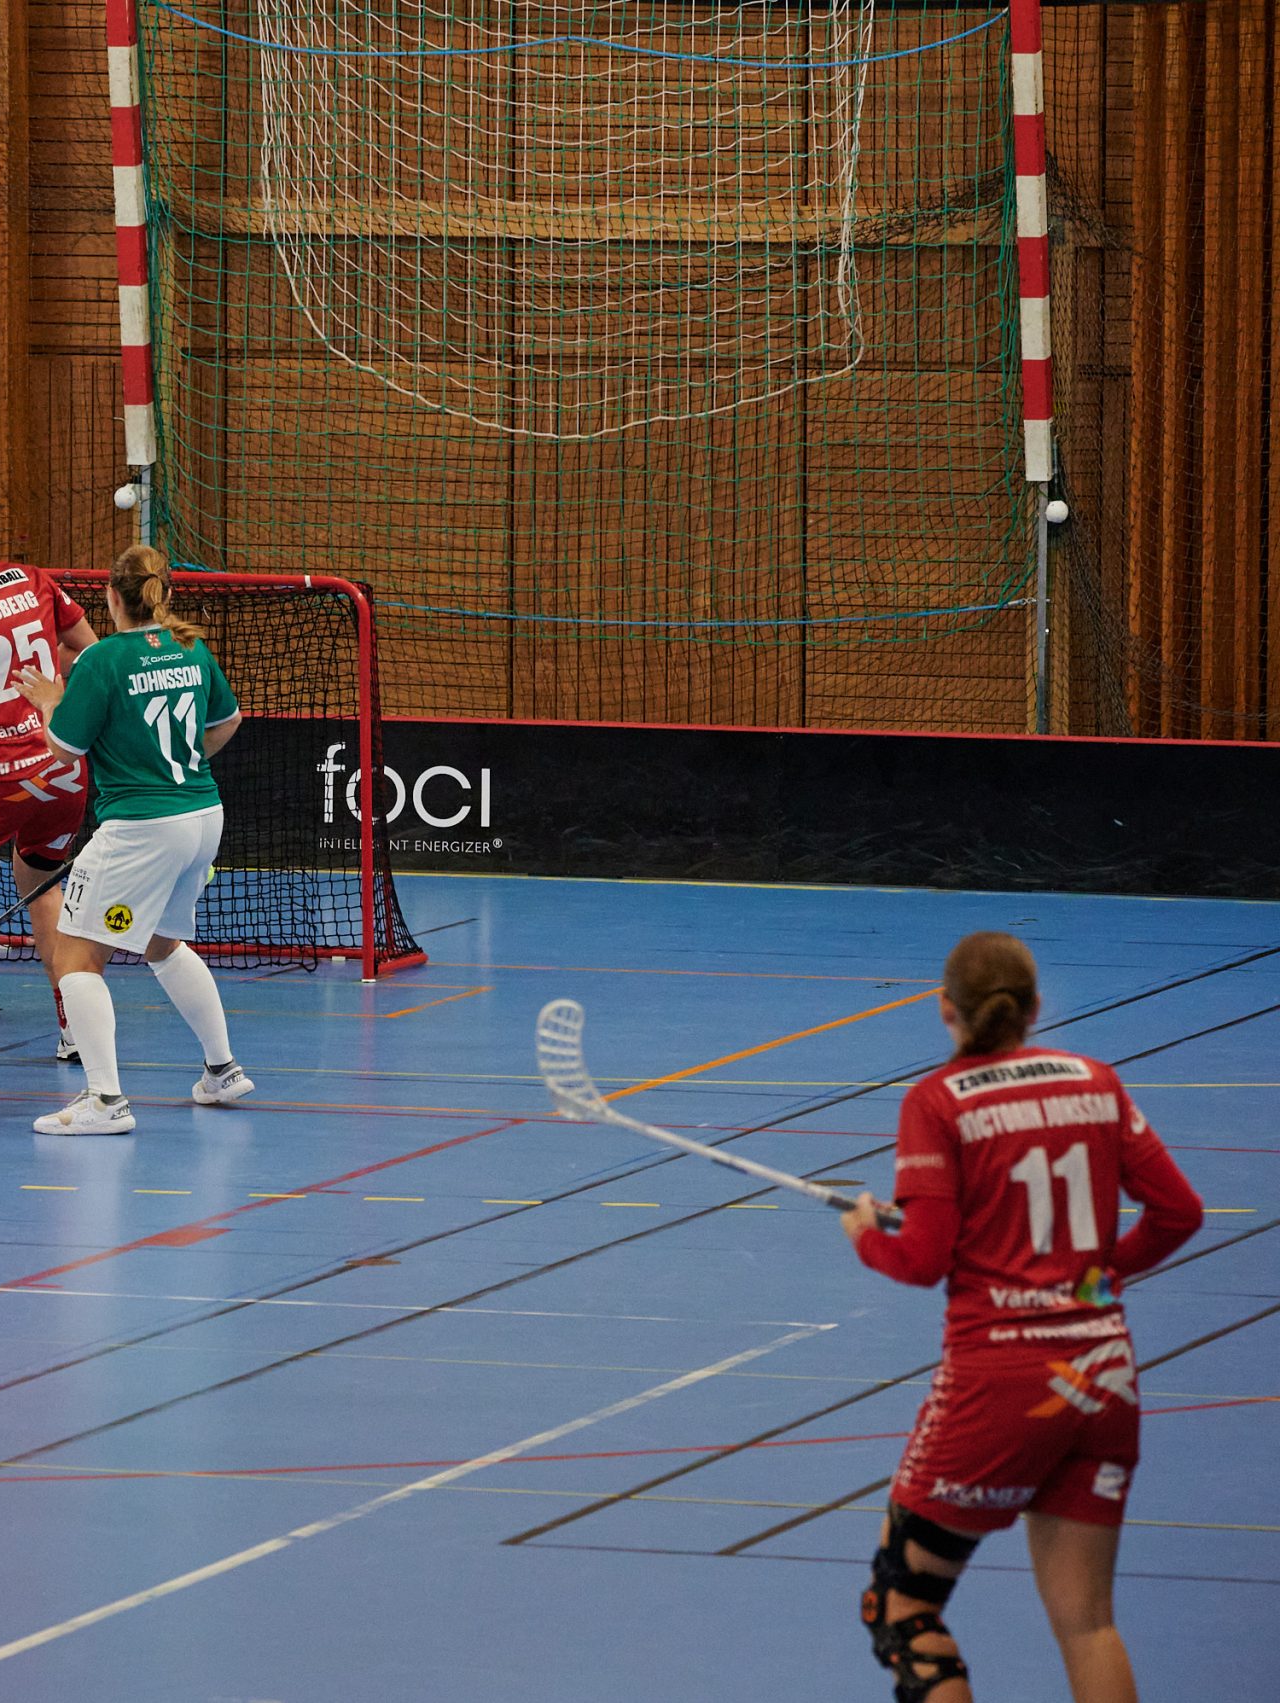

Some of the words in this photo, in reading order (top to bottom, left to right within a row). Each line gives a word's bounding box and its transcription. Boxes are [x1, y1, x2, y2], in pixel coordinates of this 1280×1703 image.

[128, 665, 202, 696] JOHNSSON
[143, 691, 201, 785] 11
[69, 881, 84, 903] 11
[1010, 1142, 1099, 1254] 11
